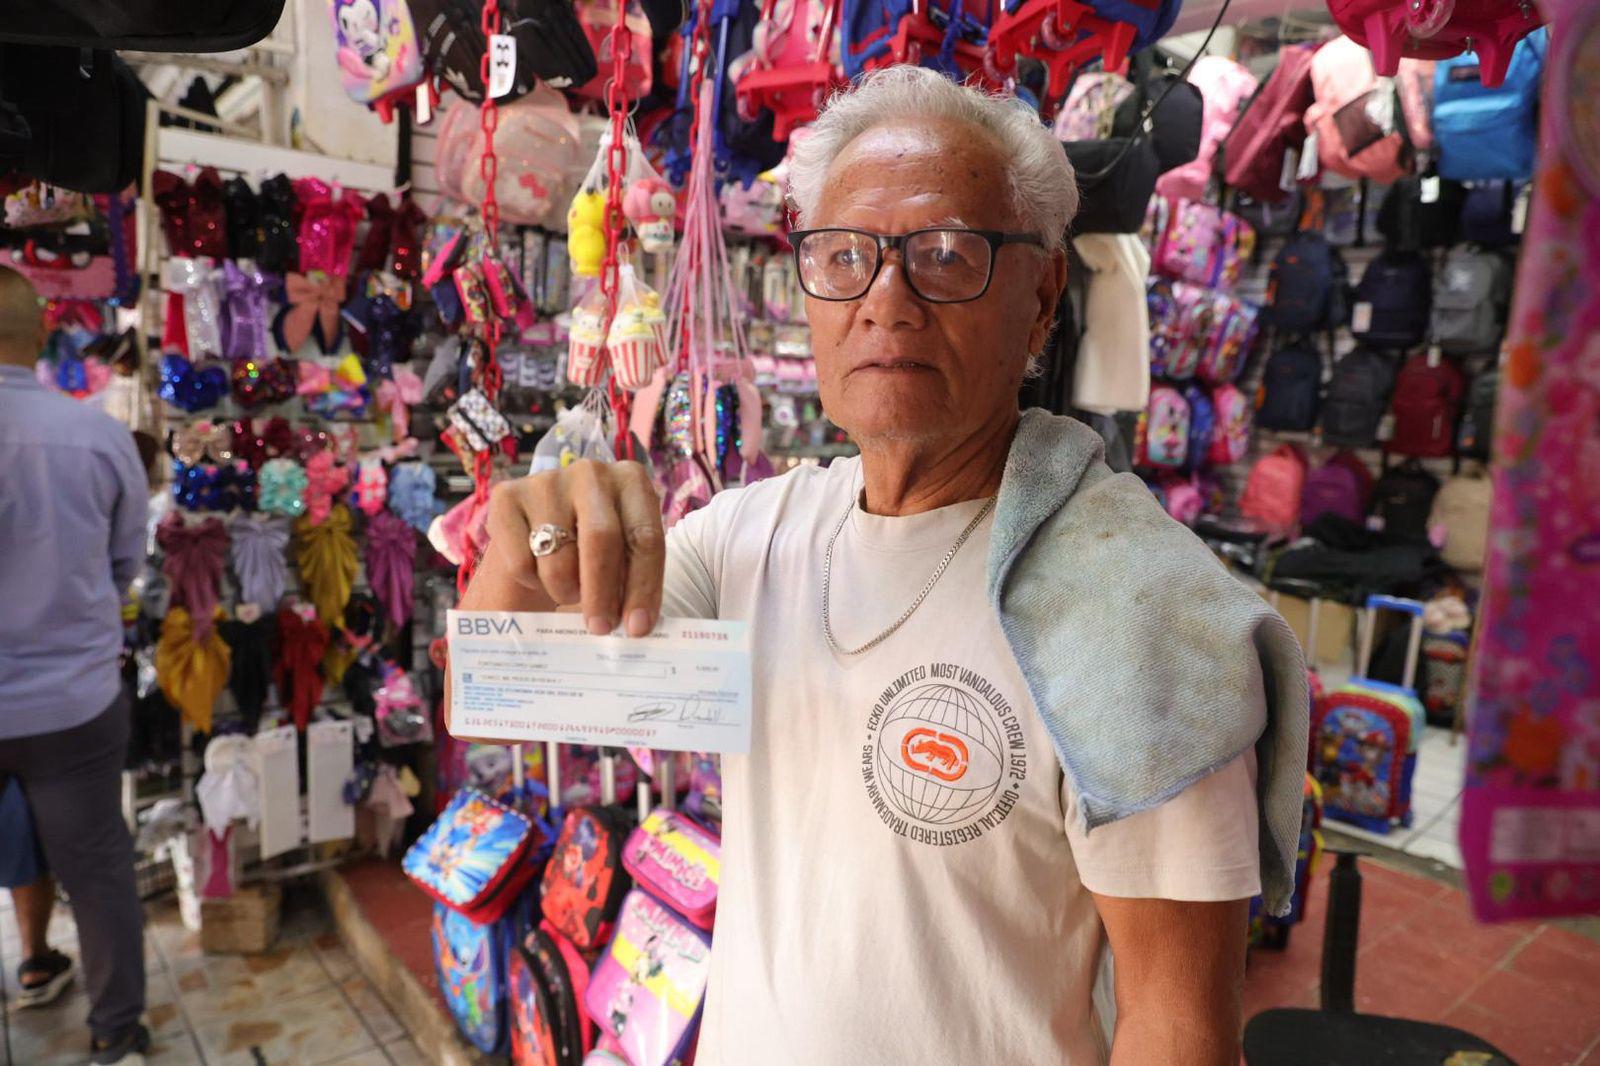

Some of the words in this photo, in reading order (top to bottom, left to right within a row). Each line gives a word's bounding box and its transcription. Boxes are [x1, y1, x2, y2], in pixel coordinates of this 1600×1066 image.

[458, 617, 523, 635] BBVA
[882, 665, 926, 706] UNLIMITED
[930, 662, 959, 679] MOST
[957, 667, 1012, 717] VANDALOUS
[867, 704, 884, 731] ECKO
[1003, 716, 1026, 750] CREW
[861, 745, 874, 785] WEARS
[1009, 752, 1027, 780] 1972
[865, 784, 909, 838] TRADEMARK
[983, 790, 1019, 831] OFFICIAL
[910, 826, 982, 847] REGISTERED
